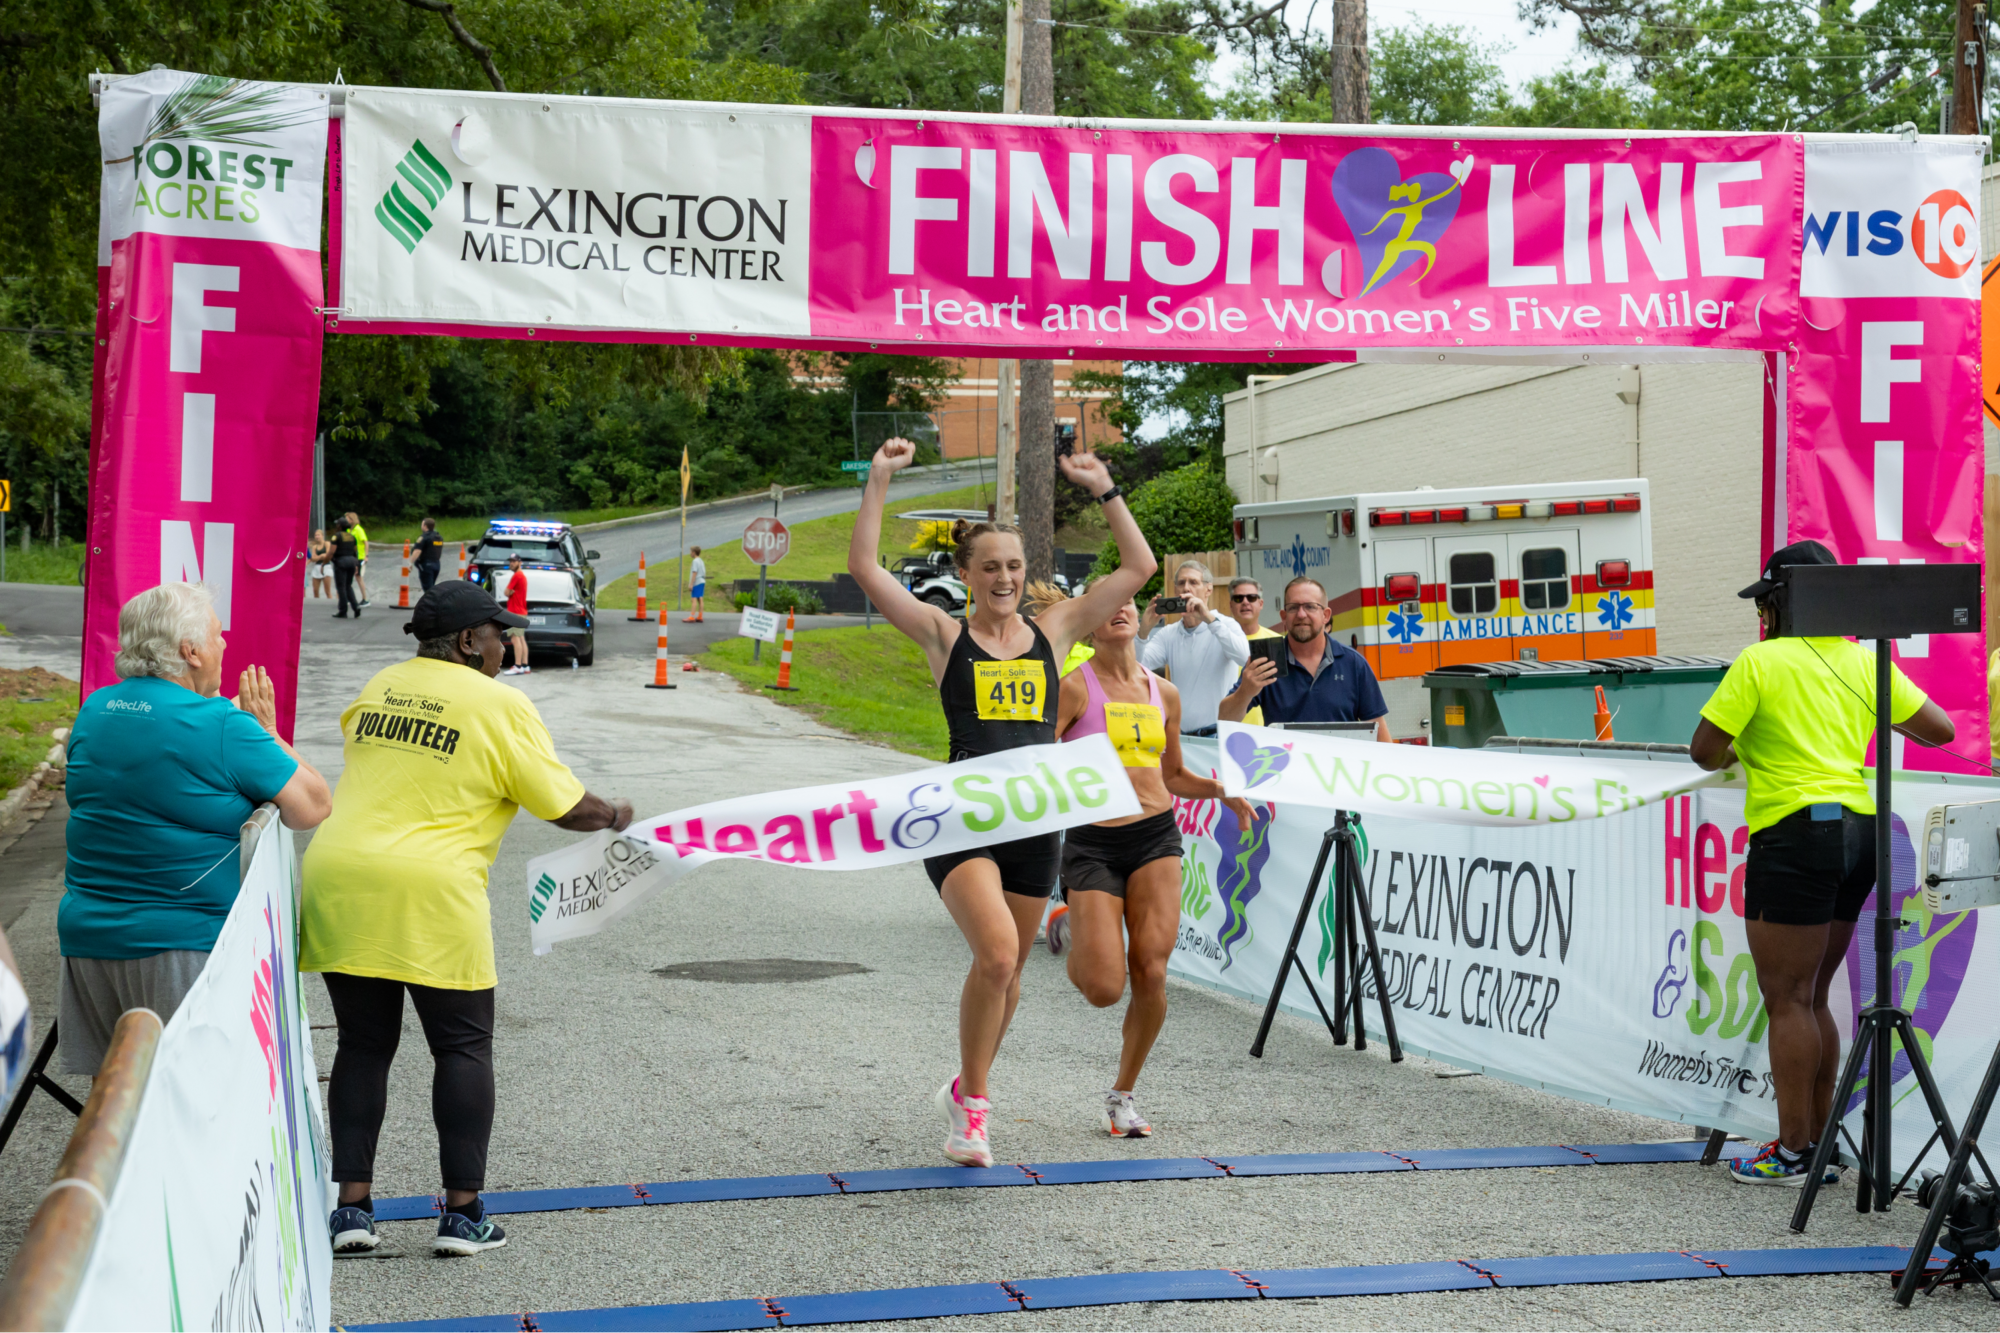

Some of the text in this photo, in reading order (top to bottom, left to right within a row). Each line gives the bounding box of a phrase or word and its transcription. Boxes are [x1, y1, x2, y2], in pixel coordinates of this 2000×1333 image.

[133, 142, 293, 193] FOREST
[132, 179, 260, 224] ACRES
[460, 181, 789, 245] LEXINGTON
[888, 144, 1765, 287] FINISH LINE
[460, 230, 786, 283] MEDICAL CENTER
[894, 288, 1734, 334] Heart and Sole Women's Five Miler
[842, 462, 873, 471] LAKESHO
[745, 530, 787, 551] STOP
[1263, 546, 1331, 569] RICHLAND COUNTY
[1442, 613, 1577, 641] AMBULANCE
[1608, 632, 1624, 641] 232
[1398, 645, 1414, 654] 232
[980, 669, 1002, 677] Heart
[1008, 668, 1026, 677] Sole
[384, 695, 413, 708] Heart
[419, 699, 444, 714] Sole
[414, 693, 433, 701] Medical
[433, 696, 452, 705] Center
[989, 680, 1036, 705] 419
[382, 705, 440, 721] Women's Five Miler
[1109, 710, 1128, 718] Heart
[1132, 711, 1146, 719] Sole
[355, 712, 460, 755] VOLUNTEER
[1131, 723, 1141, 743] 1
[654, 762, 1109, 864] Heart & Sole
[1665, 796, 1749, 917] Hea
[606, 850, 660, 893] CENTER
[1369, 849, 1576, 965] LEXINGTON
[1461, 962, 1561, 1040] CENTER
[1637, 1039, 1714, 1085] Women's
[1712, 1056, 1757, 1094] Five
[1932, 1272, 1961, 1281] Cnon
